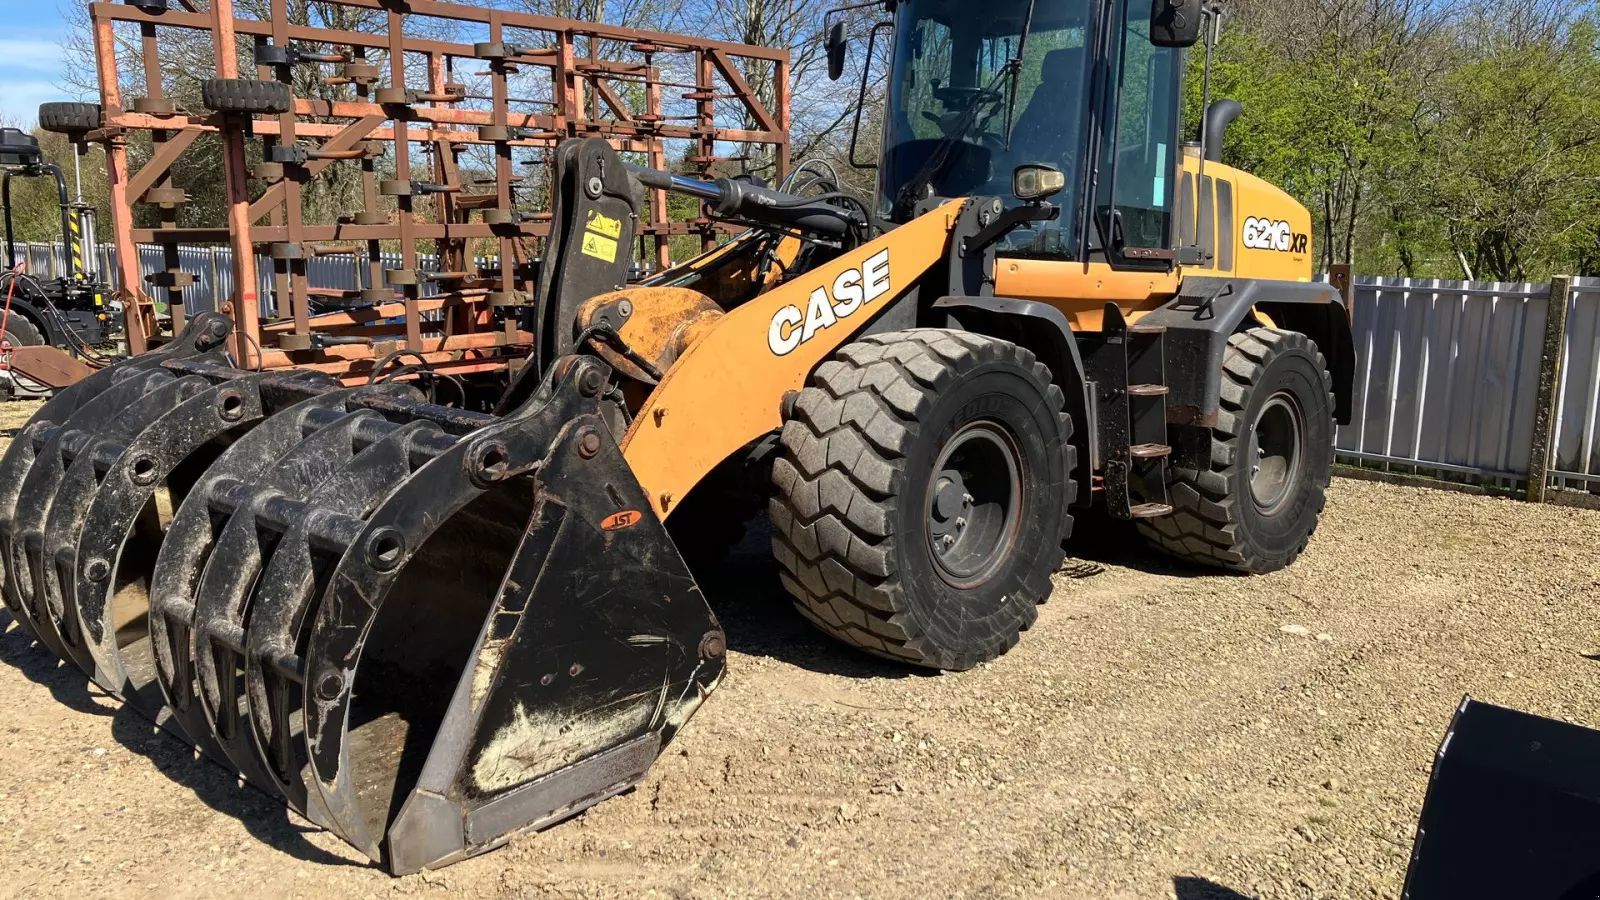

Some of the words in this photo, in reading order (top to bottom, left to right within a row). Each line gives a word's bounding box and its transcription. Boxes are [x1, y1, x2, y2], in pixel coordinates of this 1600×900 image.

[1243, 216, 1290, 252] 621G
[1290, 233, 1308, 254] XR
[767, 247, 891, 357] CASE
